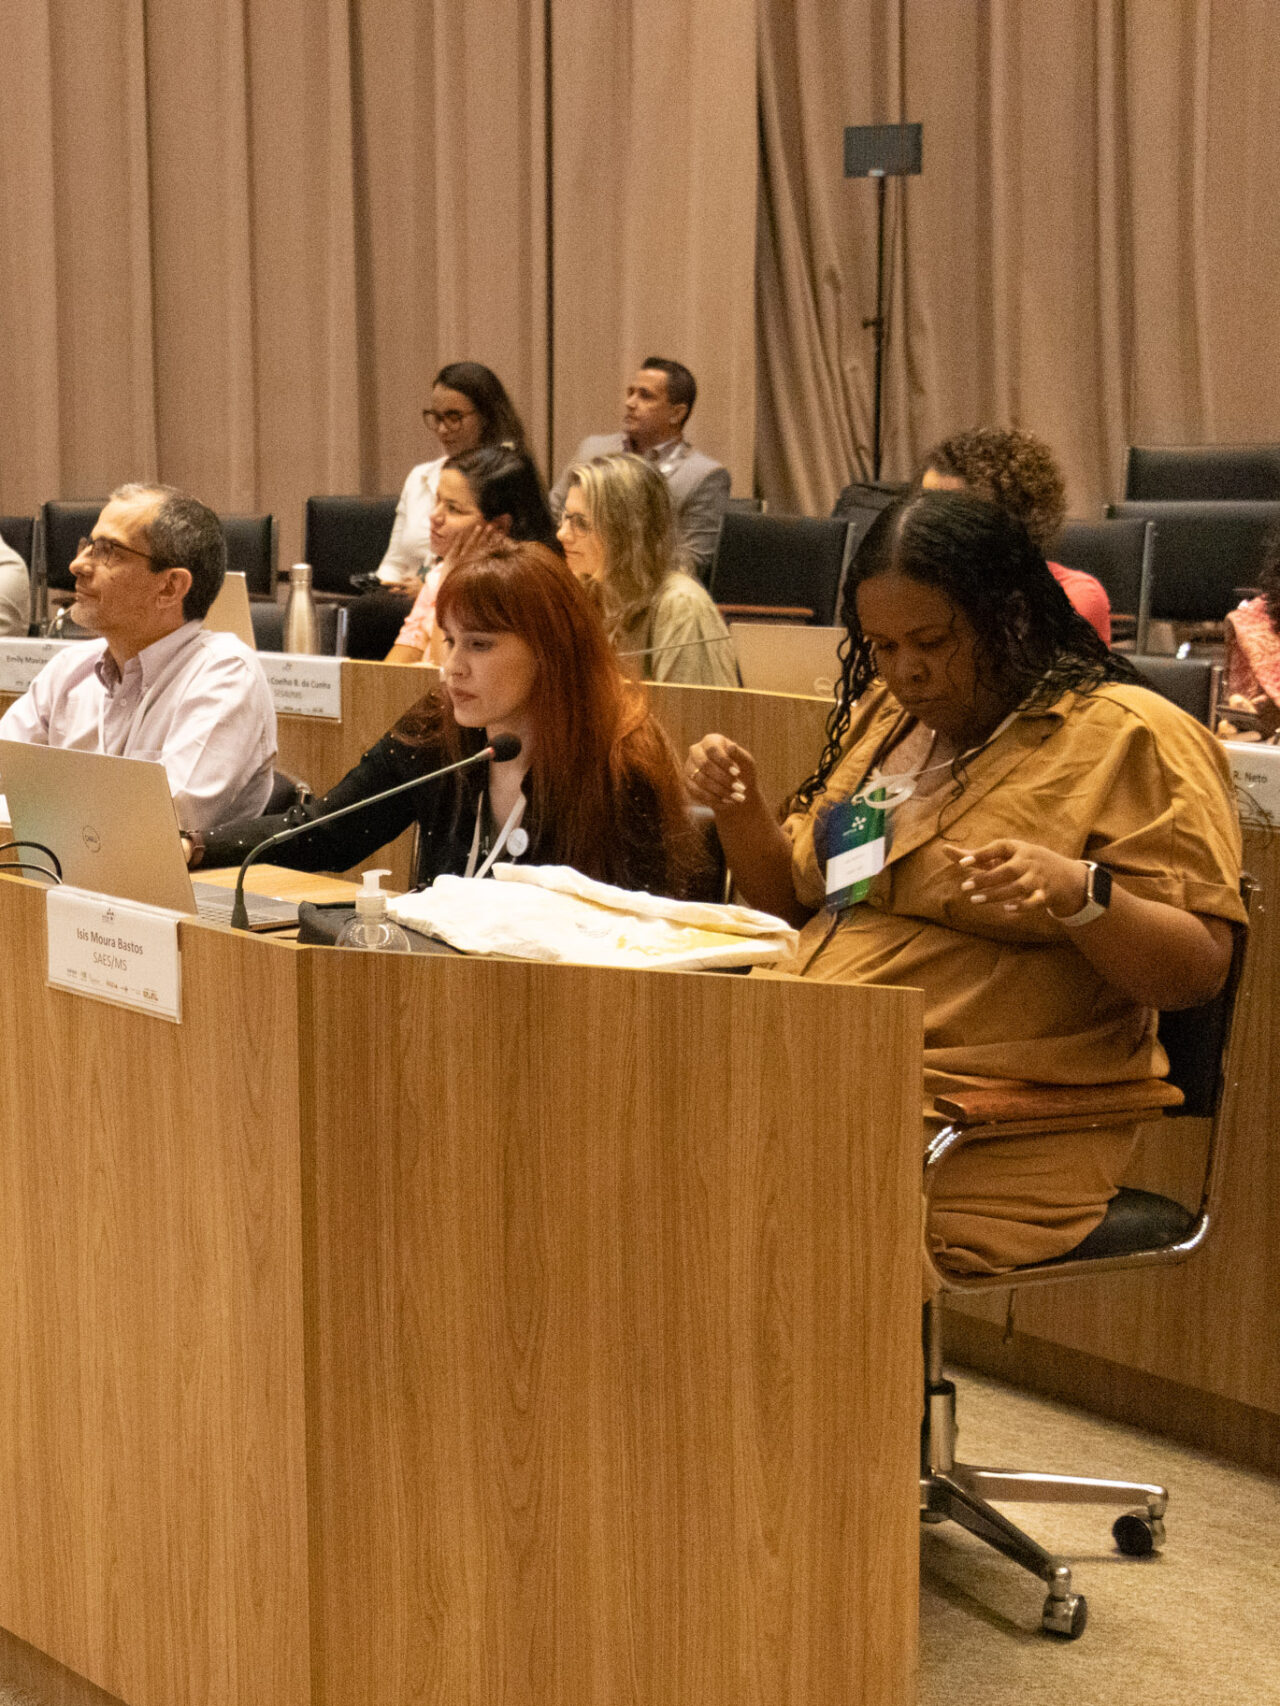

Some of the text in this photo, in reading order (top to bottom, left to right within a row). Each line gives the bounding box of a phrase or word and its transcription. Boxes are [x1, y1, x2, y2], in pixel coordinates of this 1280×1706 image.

[1245, 771, 1268, 783] Neto
[76, 927, 144, 955] Isis Moura Bastos
[92, 951, 128, 971] SAES/MS
